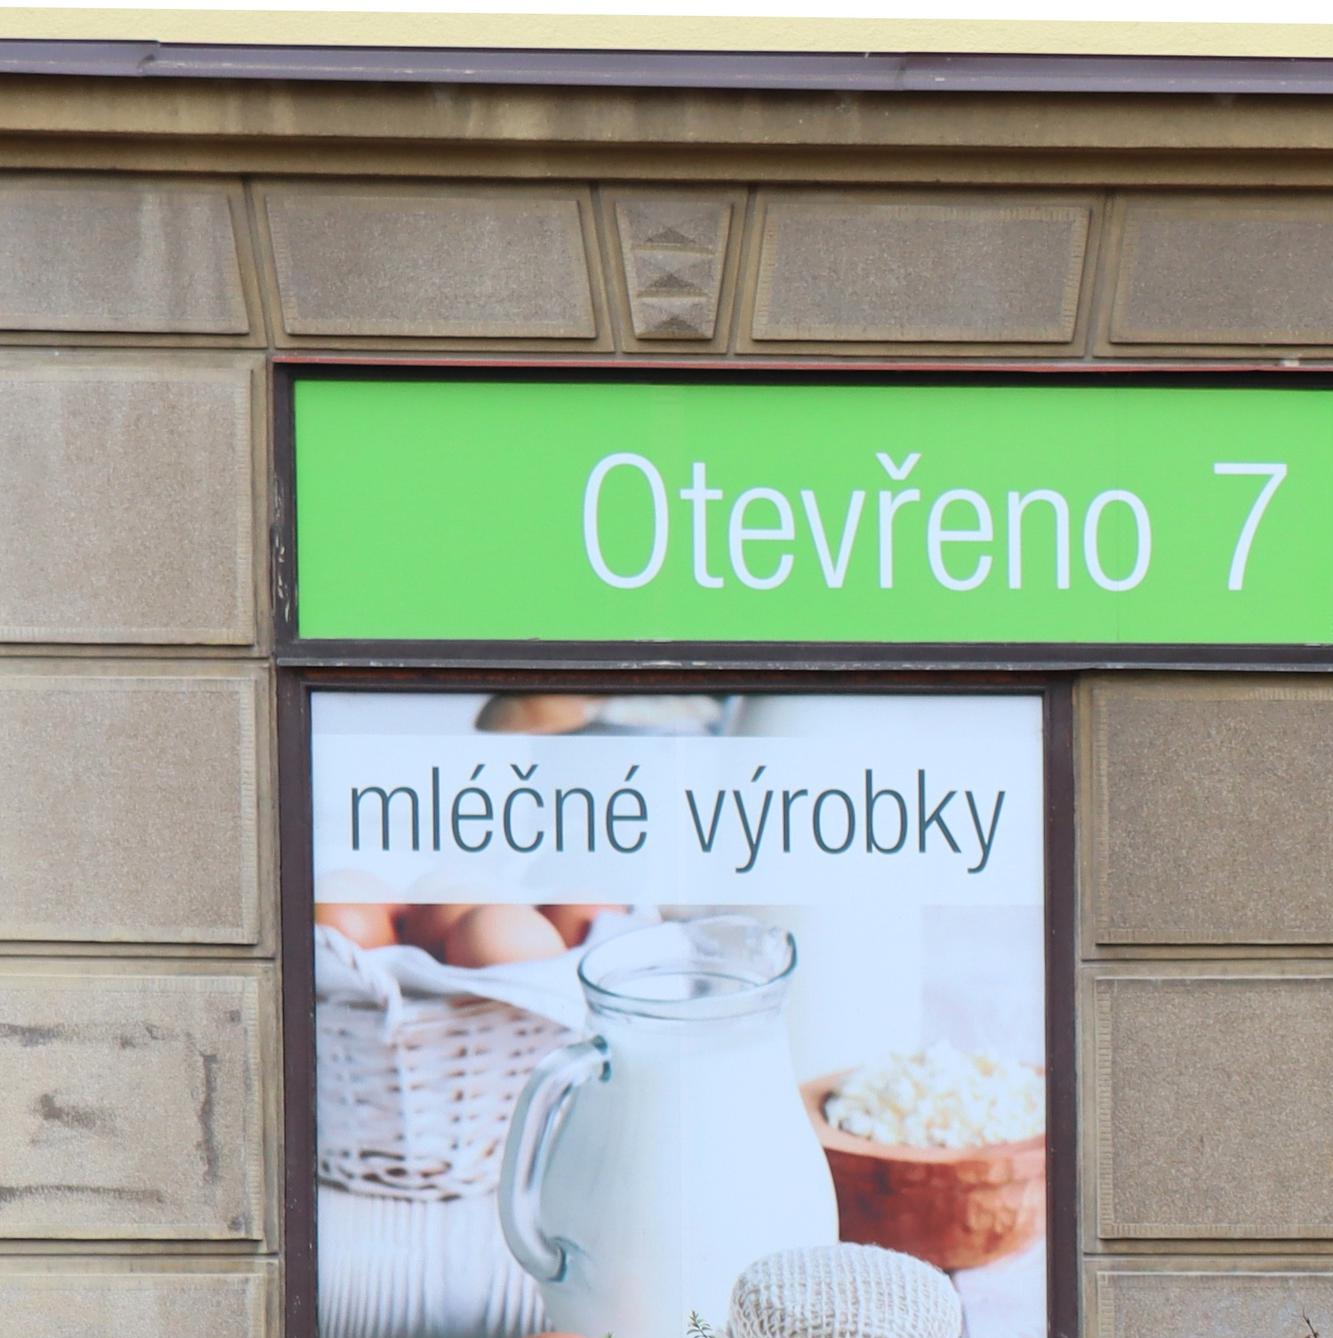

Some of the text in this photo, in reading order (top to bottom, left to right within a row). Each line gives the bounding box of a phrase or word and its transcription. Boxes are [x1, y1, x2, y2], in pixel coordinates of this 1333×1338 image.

[583, 452, 1152, 592] Otevřeno
[1212, 461, 1289, 592] 7
[350, 763, 1006, 874] mléčné výrobky
